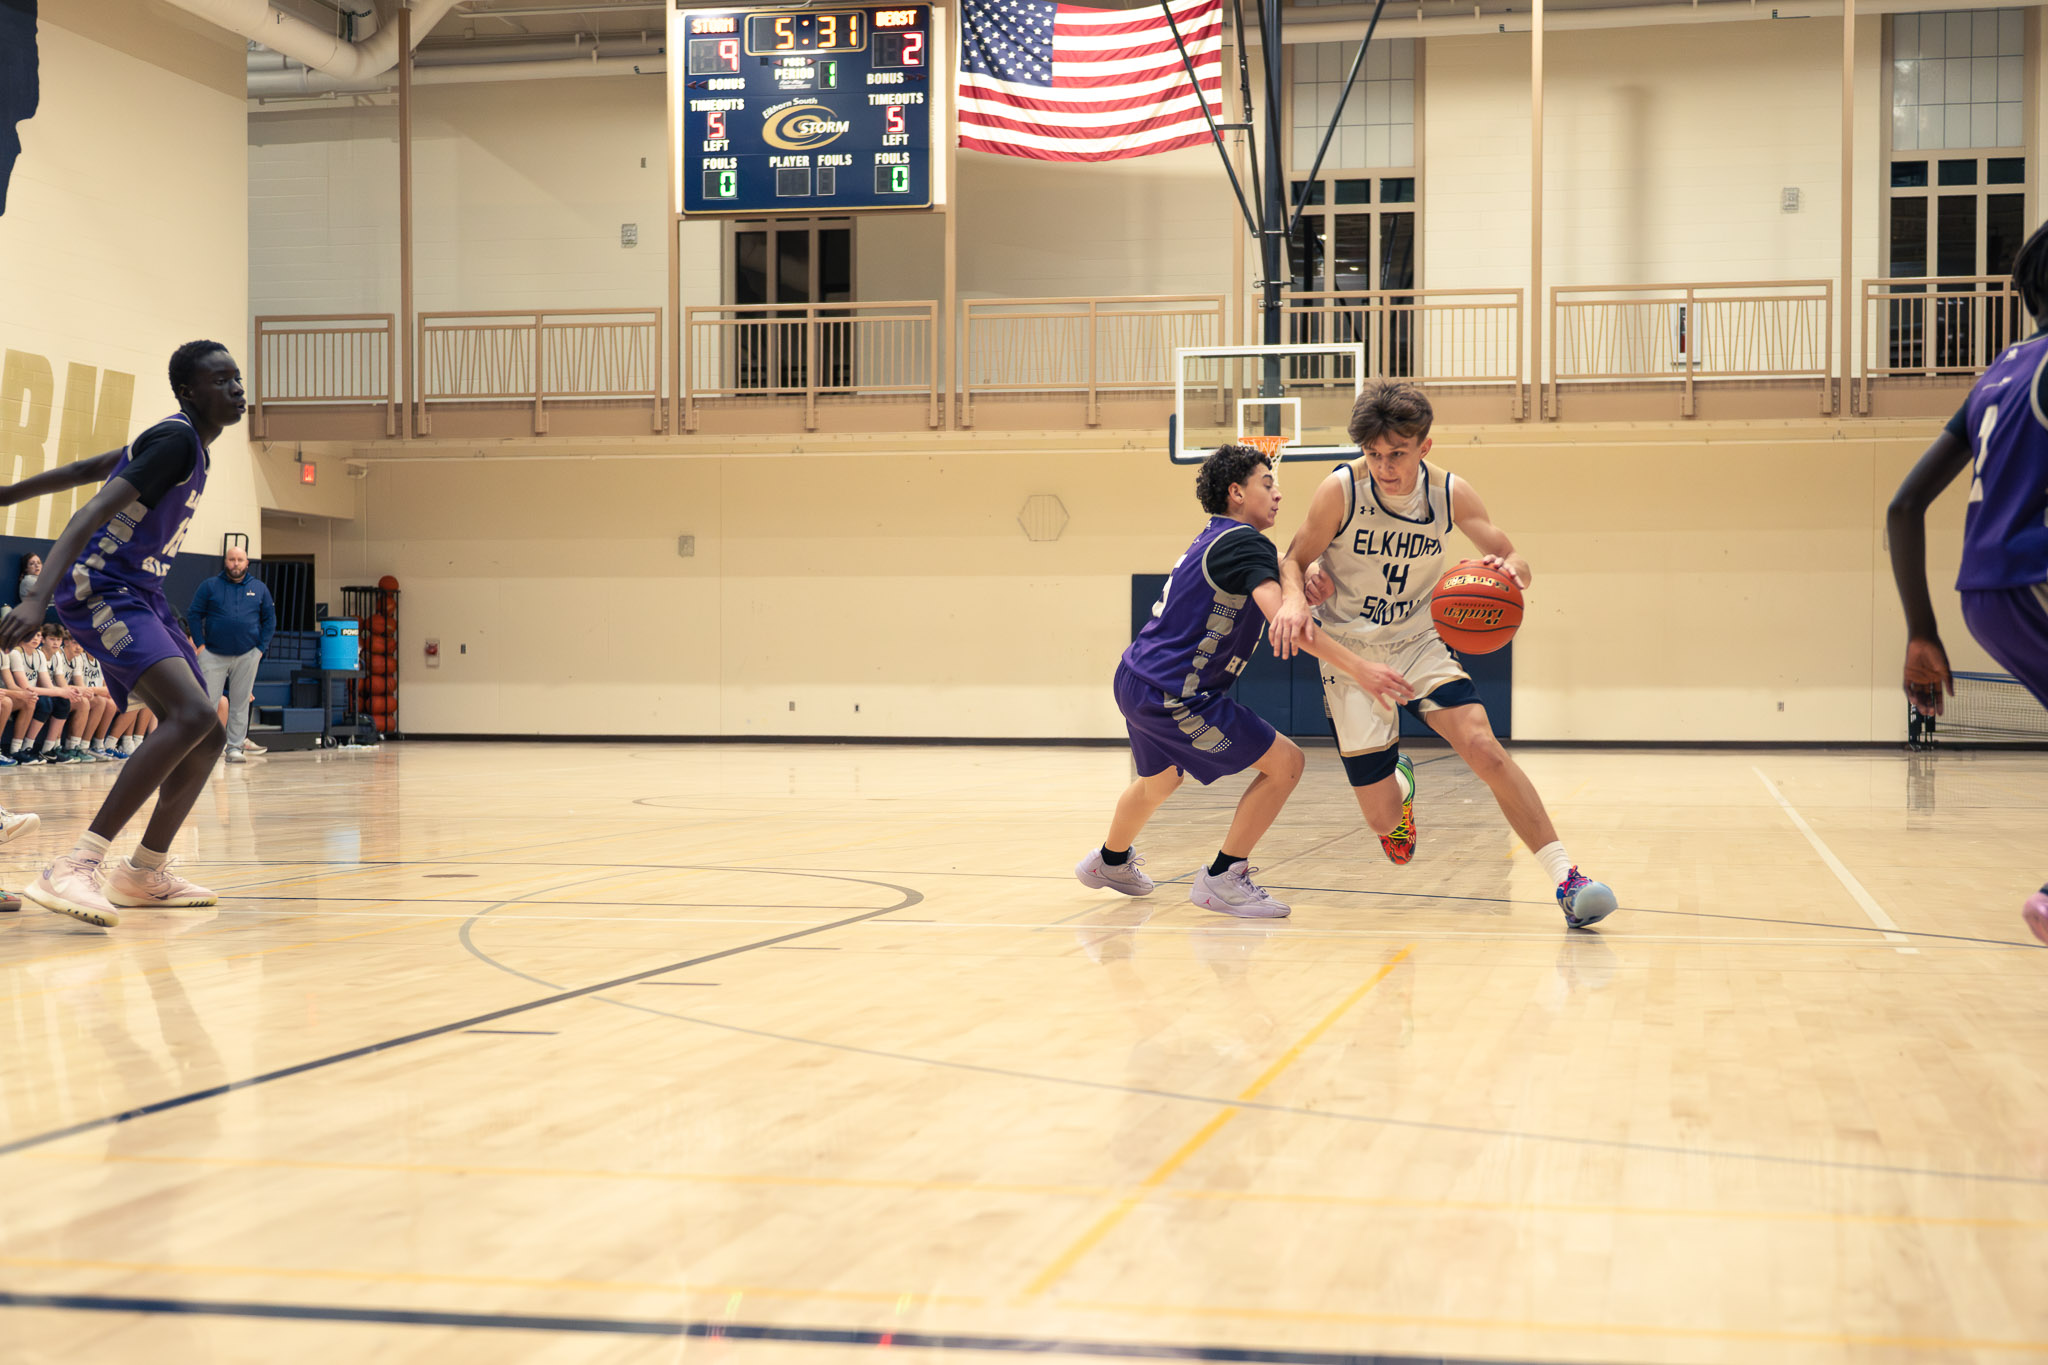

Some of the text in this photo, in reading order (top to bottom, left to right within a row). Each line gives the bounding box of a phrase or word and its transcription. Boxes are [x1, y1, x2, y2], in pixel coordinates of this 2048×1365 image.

[691, 18, 735, 34] STORM
[876, 10, 917, 27] BEAST
[775, 15, 857, 50] 5:31
[719, 40, 738, 71] 9
[902, 32, 923, 65] 2
[774, 67, 815, 81] PERIOD
[829, 62, 836, 87] 1
[866, 72, 904, 85] BONUS
[708, 78, 746, 91] BONUS
[690, 98, 745, 112] TIMEOUTS
[868, 92, 924, 106] TIMEOUTS
[761, 96, 818, 119] Elkhorn South
[709, 112, 725, 138] 5
[799, 120, 850, 134] STORM
[887, 106, 904, 132] 5
[703, 139, 730, 152] LEFT
[882, 134, 910, 146] LEFT
[702, 157, 737, 170] FOULS
[769, 153, 852, 168] PLAYER FOULS
[875, 152, 910, 165] FOULS
[720, 171, 736, 197] 0
[892, 166, 909, 192] 0
[1382, 562, 1410, 596] 14
[1443, 606, 1504, 626] Baden
